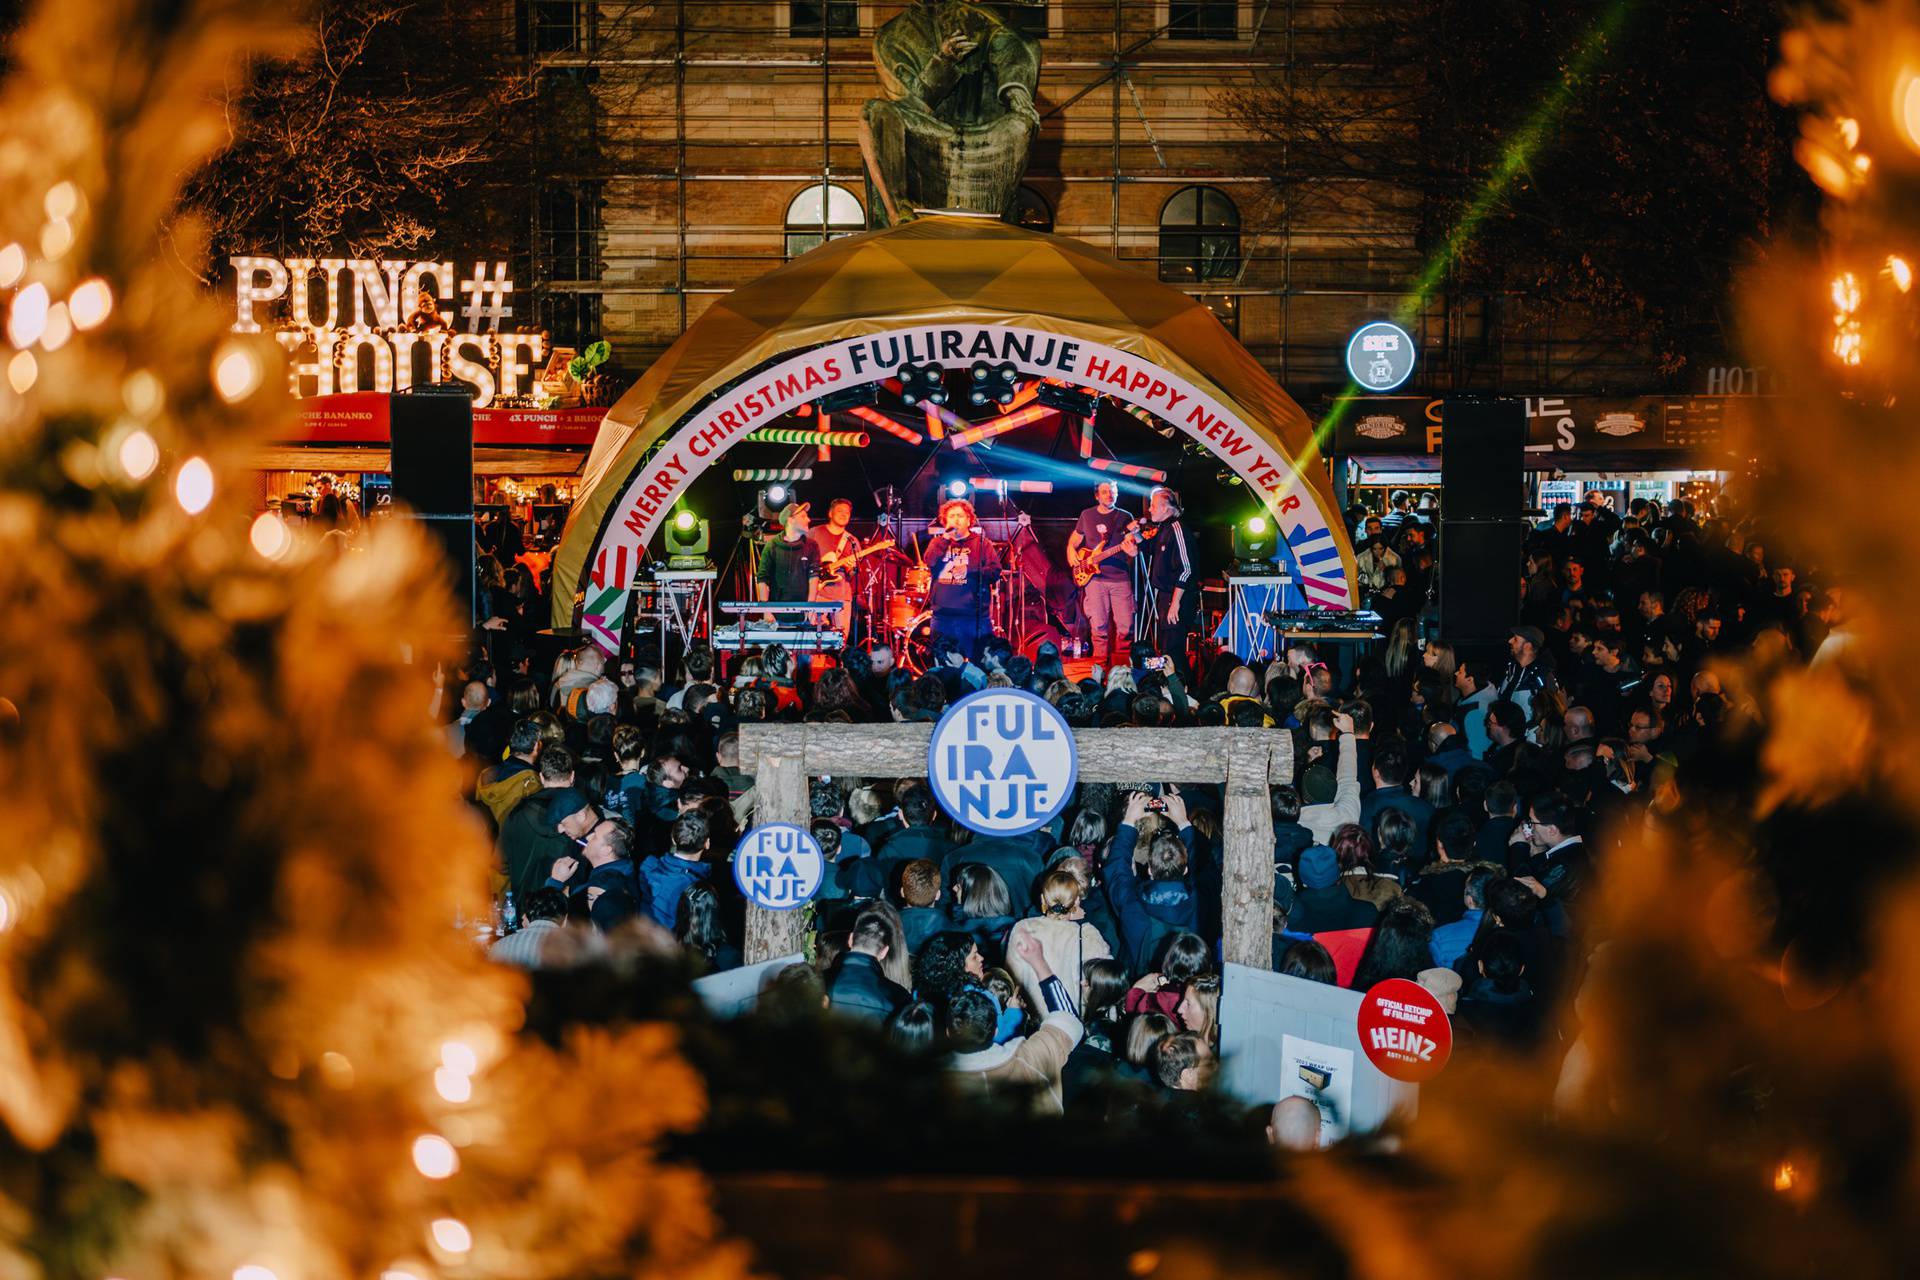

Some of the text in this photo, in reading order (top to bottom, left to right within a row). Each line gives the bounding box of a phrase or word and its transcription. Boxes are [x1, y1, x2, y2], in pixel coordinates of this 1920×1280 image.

[276, 332, 546, 409] HOUSE
[323, 411, 374, 421] BANANKO
[523, 414, 557, 423] PUNCH
[623, 330, 1301, 538] MERRY CHRISTMAS FULIRANJE HAPPY NEW YEAR
[966, 704, 1056, 741] FUL
[947, 744, 1038, 781] IRA
[959, 783, 1049, 820] NJE
[758, 832, 811, 854] FUL
[746, 856, 800, 878] IRA
[752, 879, 807, 901] NJE
[1376, 997, 1403, 1012] OFFICIAL
[1370, 1027, 1437, 1062] HEINZ
